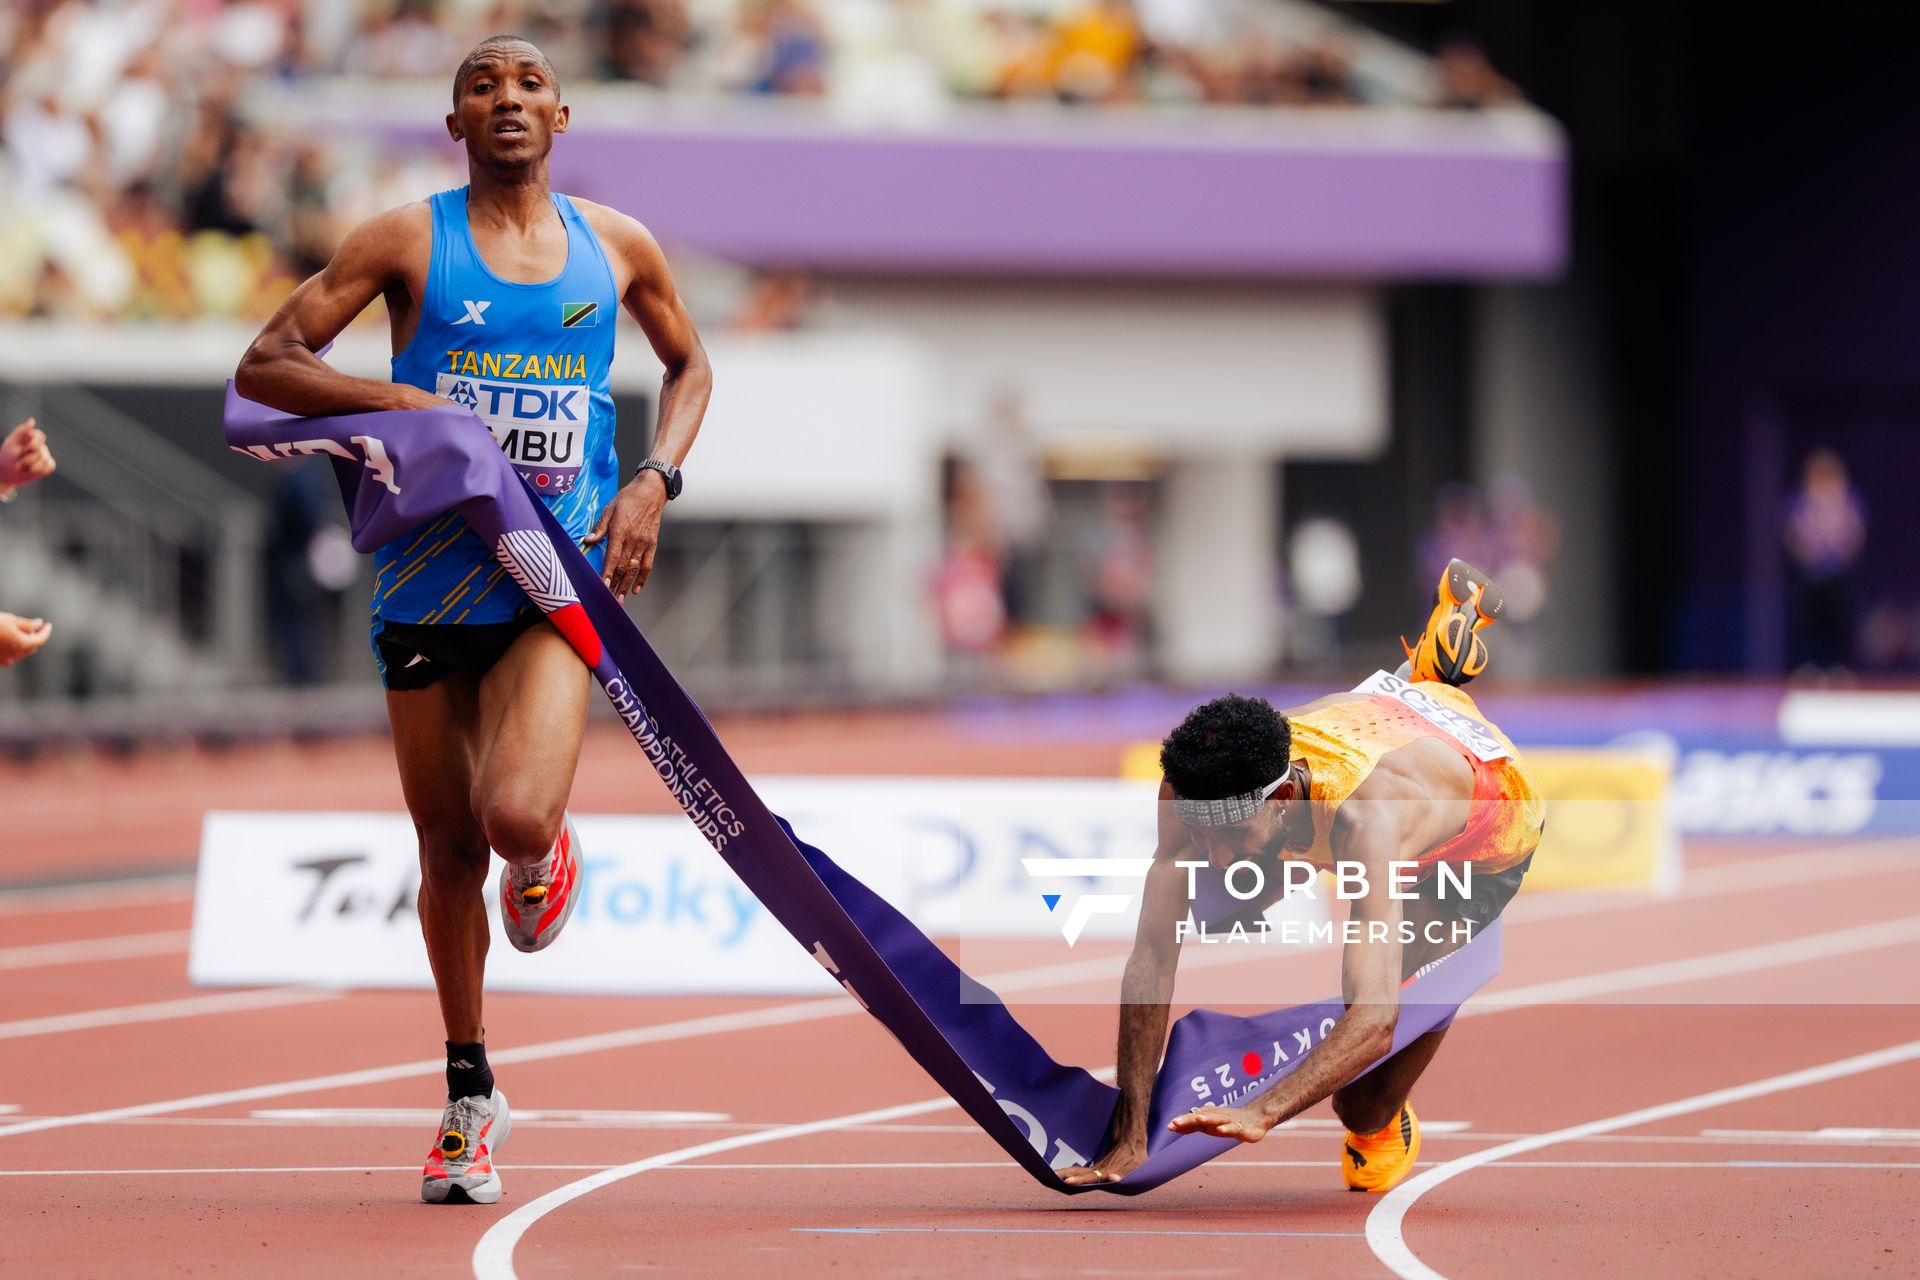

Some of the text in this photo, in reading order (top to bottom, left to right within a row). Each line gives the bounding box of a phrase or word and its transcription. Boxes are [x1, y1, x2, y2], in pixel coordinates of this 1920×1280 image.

[446, 350, 587, 379] TANZANIA
[478, 384, 579, 421] TDK
[486, 426, 573, 464] MBU
[604, 677, 728, 852] CHAMPIONSHIPS
[661, 736, 745, 837] ATHLETICS
[577, 857, 763, 948] Toky
